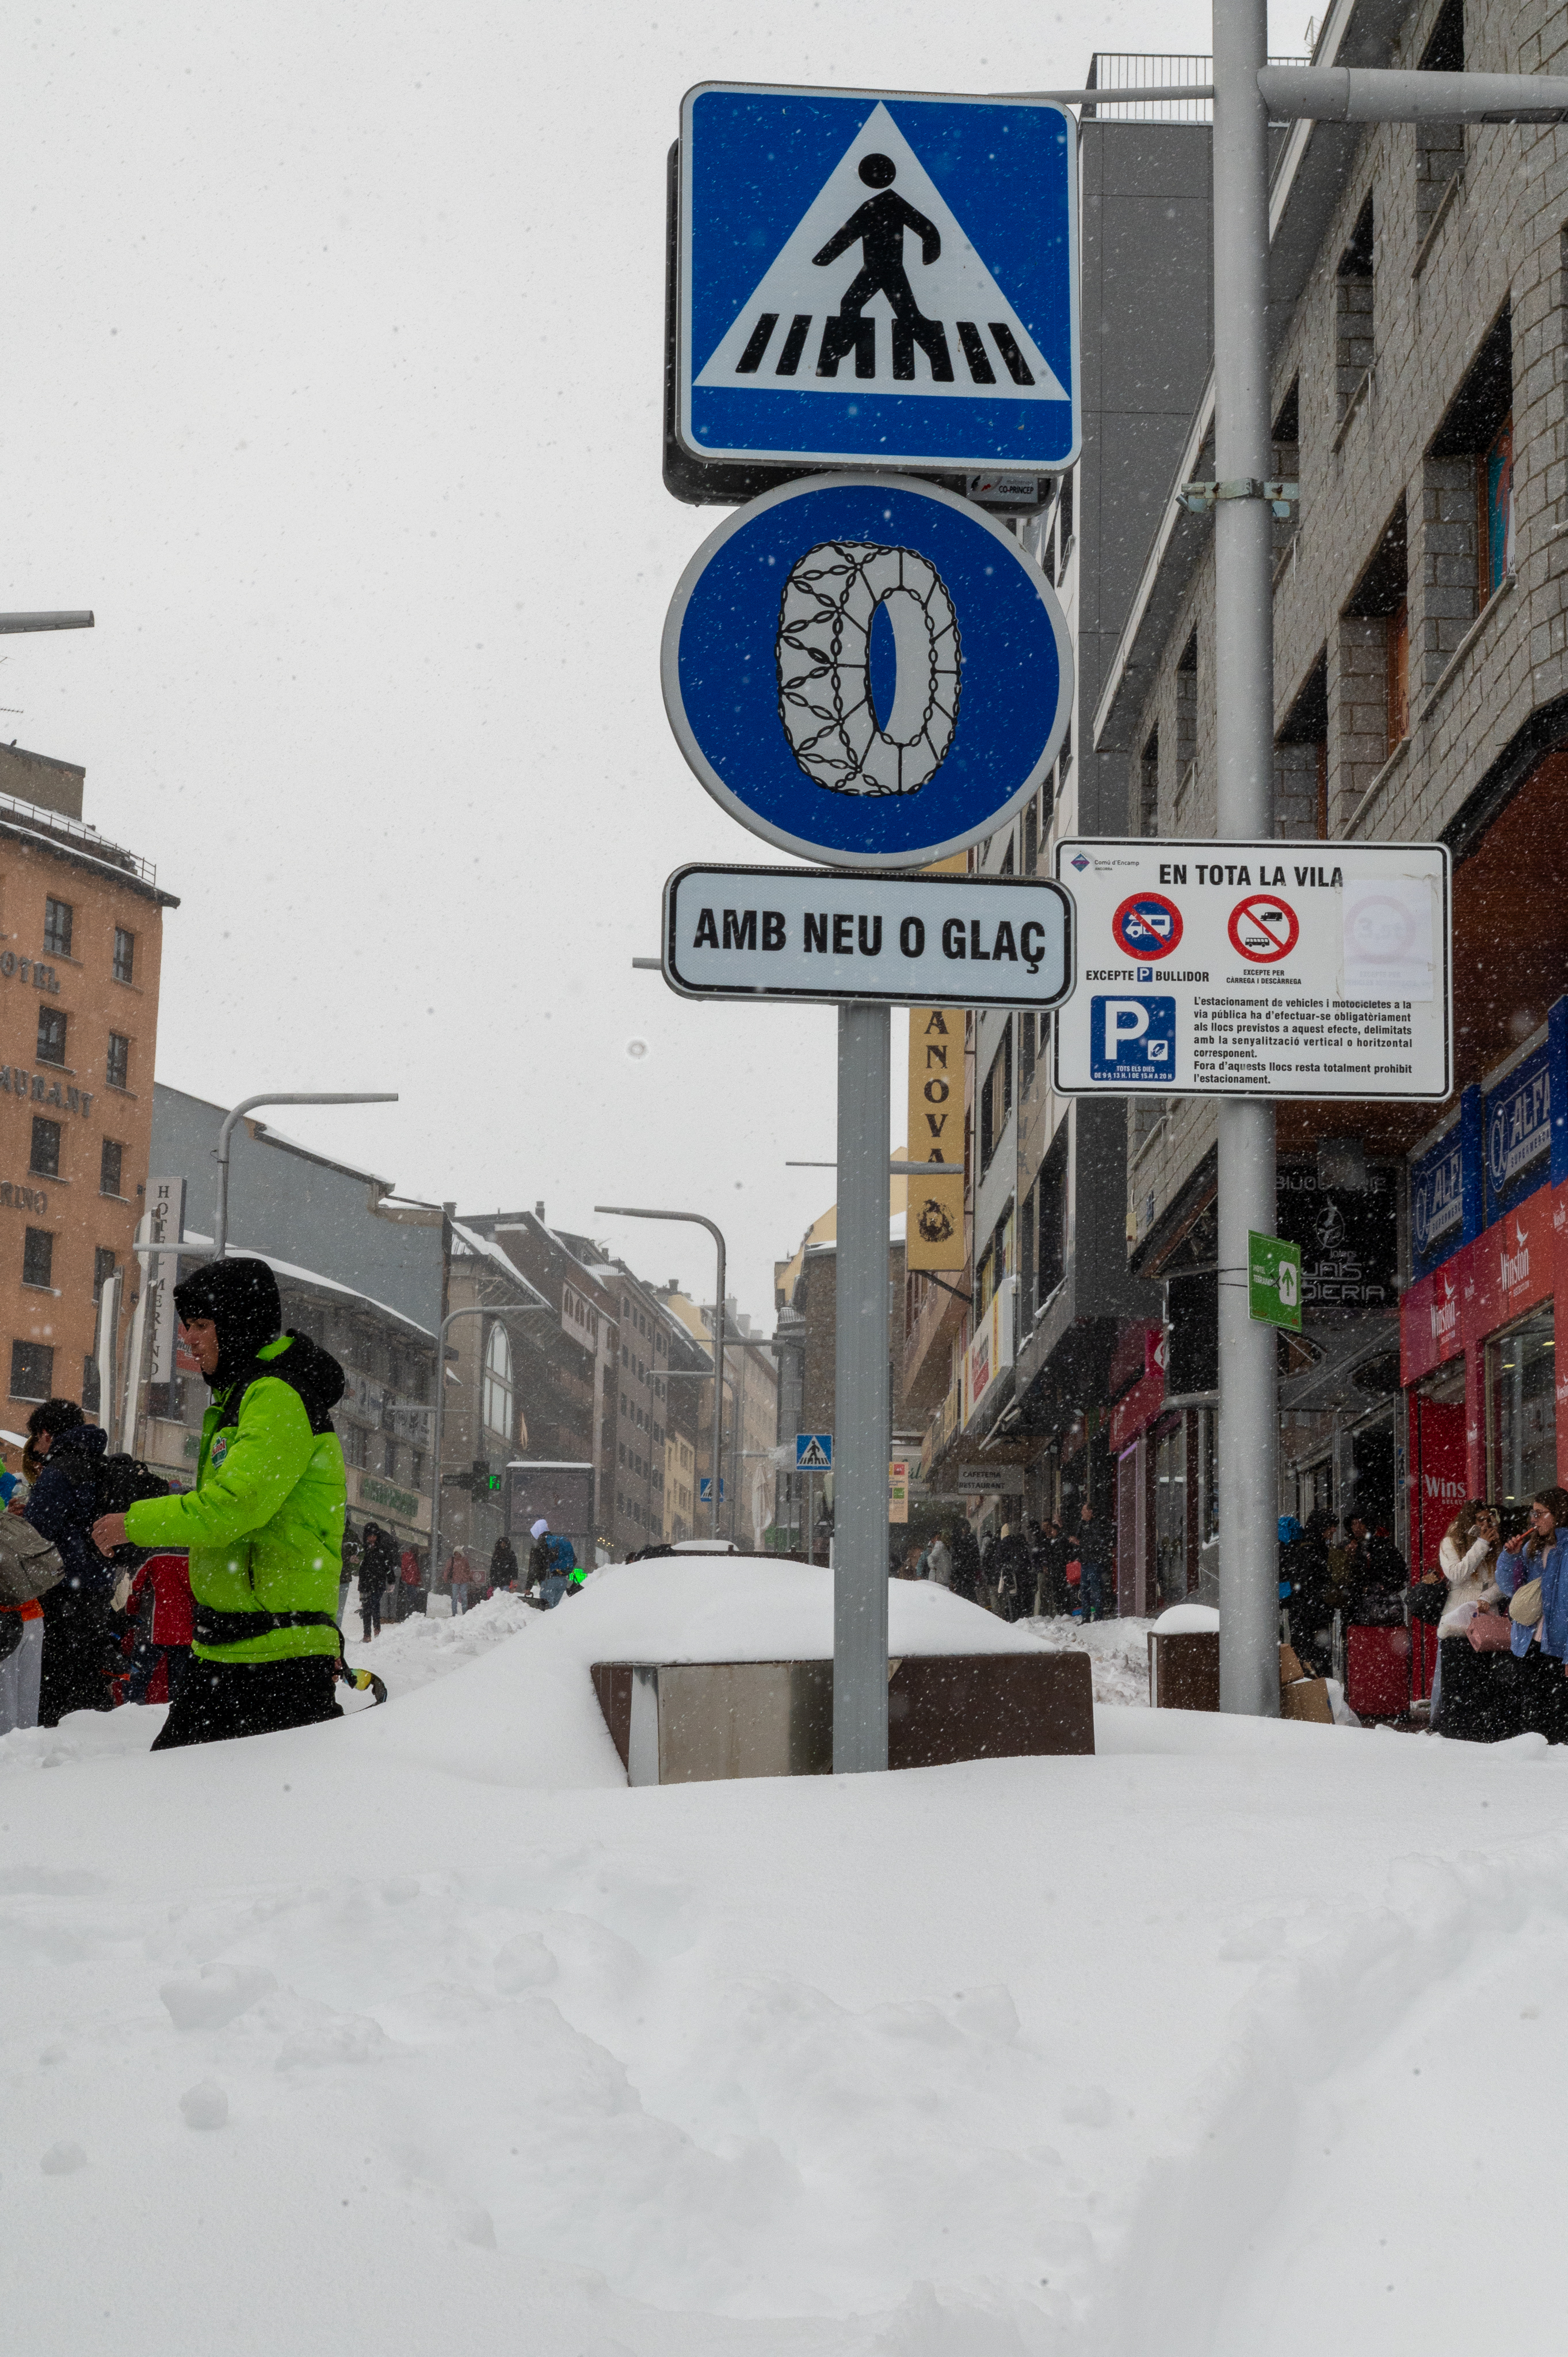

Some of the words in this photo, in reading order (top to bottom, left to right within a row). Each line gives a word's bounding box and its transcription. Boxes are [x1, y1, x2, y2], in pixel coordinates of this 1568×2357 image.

[1159, 864, 1187, 884] EN
[1195, 865, 1252, 886] TOTA
[1260, 865, 1286, 886] LA
[1294, 866, 1343, 887] VILA
[693, 908, 787, 951] AMB
[803, 912, 883, 956] NEU
[899, 916, 925, 958] O
[942, 918, 1046, 974] GLAÇ
[1086, 970, 1134, 981] EXCEPTE
[1155, 971, 1210, 982] BULLIDOR
[1226, 976, 1256, 984] CÀRREGA
[1261, 977, 1302, 985] DESCÀRREGA
[1194, 997, 1269, 1006] L'estacionament
[1272, 998, 1283, 1007] de
[1285, 998, 1323, 1008] vehicles
[1326, 999, 1329, 1007] i
[1332, 1000, 1391, 1009] motocicletes
[1403, 1001, 1411, 1009] la
[1194, 1009, 1208, 1019] via
[1211, 1009, 1247, 1020] pública
[1250, 1010, 1262, 1019] ha
[1265, 1010, 1331, 1020] d'efectuar-se
[1334, 1012, 1411, 1023] obligatòriament
[1194, 1023, 1208, 1031] als
[1211, 1023, 1234, 1032] llocs
[1237, 1023, 1280, 1033] previstos
[1292, 1024, 1324, 1035] aquest
[1327, 1025, 1361, 1035] efecte,
[1364, 1025, 1412, 1035] delimitats
[1194, 1035, 1215, 1044] amb
[1219, 1036, 1228, 1044] la
[1232, 1036, 1299, 1046] senyalització
[1304, 1037, 1342, 1046] vertical
[1357, 1038, 1412, 1047] horitzontal
[1194, 1049, 1257, 1059] corresponent.
[1194, 1061, 1215, 1070] Fora
[1219, 1061, 1266, 1072] d'aquests
[1269, 1062, 1292, 1071] llocs
[1295, 1063, 1320, 1072] resta
[1323, 1063, 1371, 1073] totalment
[1374, 1064, 1413, 1074] prohibit
[1194, 1074, 1271, 1084] l'estacionament.
[1432, 1151, 1462, 1215] ALF
[1500, 1248, 1529, 1291] Winston
[1431, 1300, 1455, 1339] Winston
